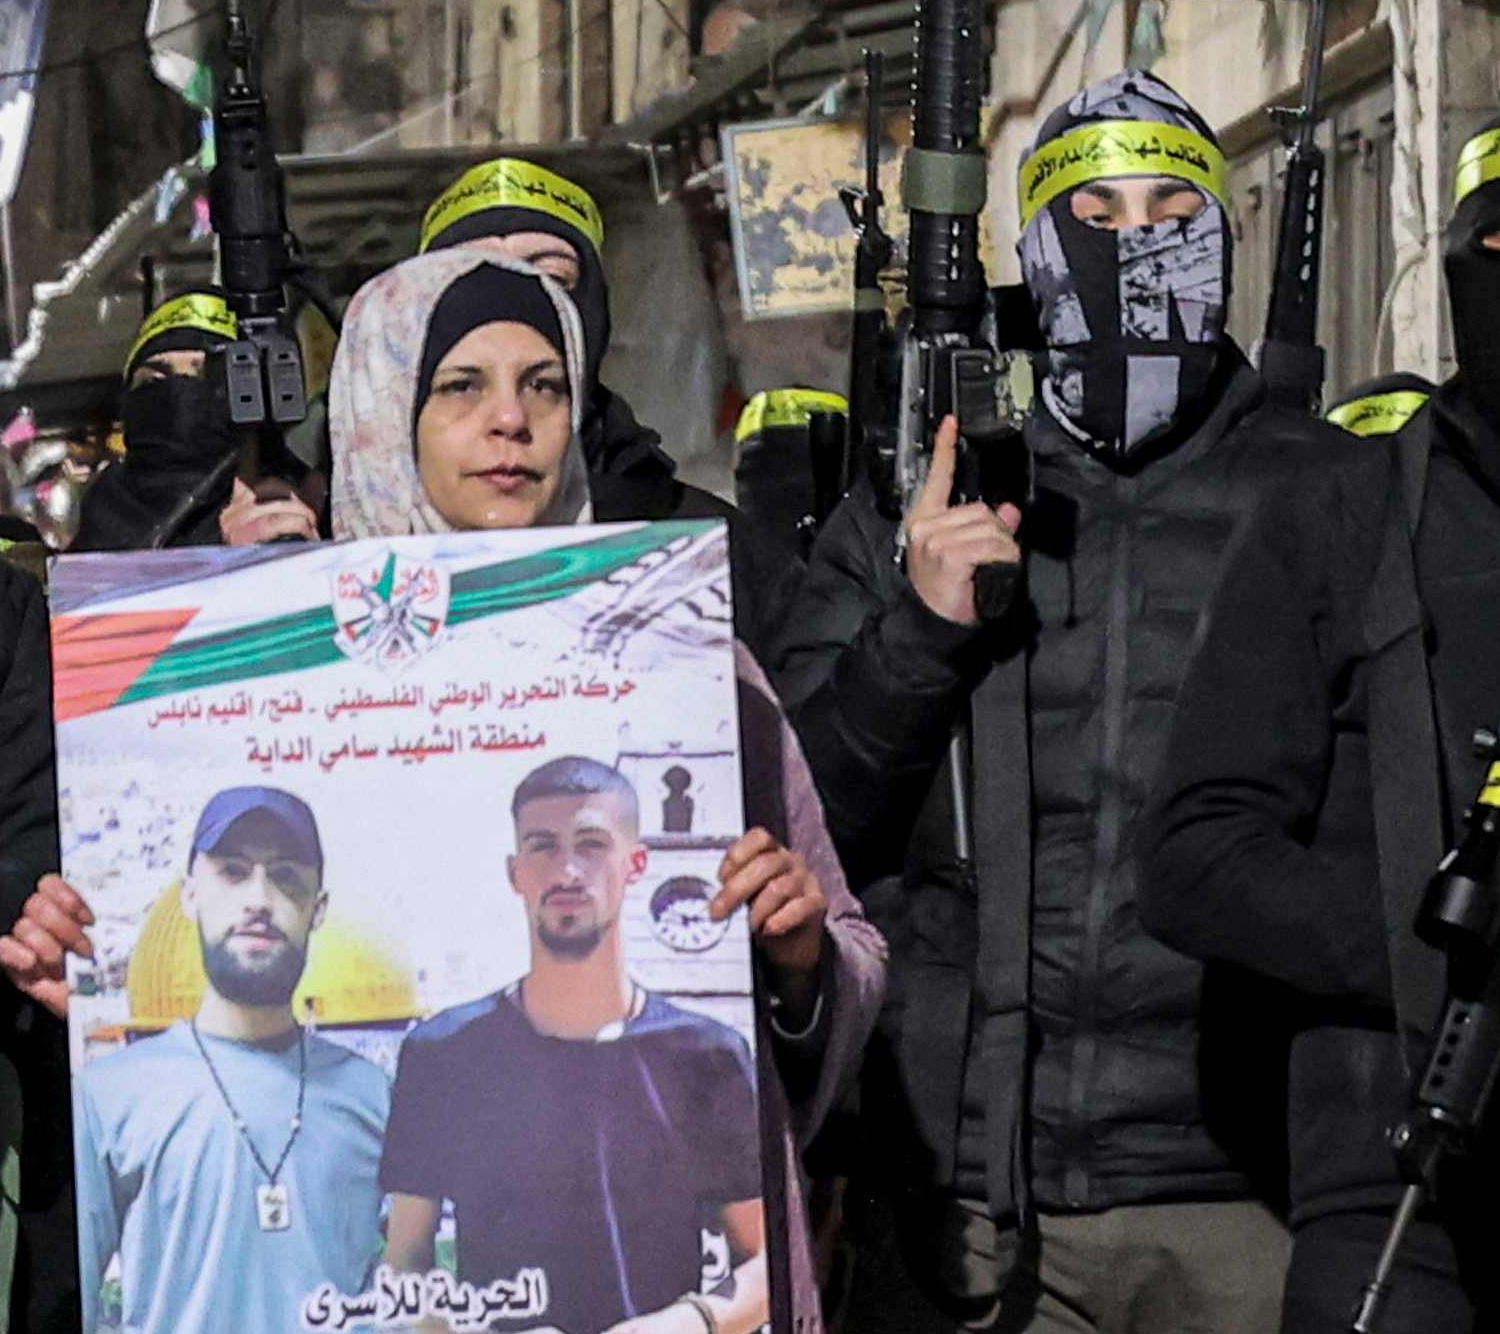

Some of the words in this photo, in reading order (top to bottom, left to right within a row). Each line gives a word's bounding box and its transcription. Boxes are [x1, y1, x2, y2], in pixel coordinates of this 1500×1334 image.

[324, 686, 424, 722] الفلسطيني
[429, 683, 490, 715] الوطني
[497, 679, 567, 711] التحرير
[572, 673, 637, 701] حركة
[147, 695, 203, 729] نابلس
[246, 735, 313, 769] الداية
[318, 734, 379, 771] سامي
[385, 725, 462, 767] الشهيد
[469, 722, 547, 756] منطقة
[304, 1267, 423, 1330] للأسرى
[436, 1270, 548, 1325] الحرية
